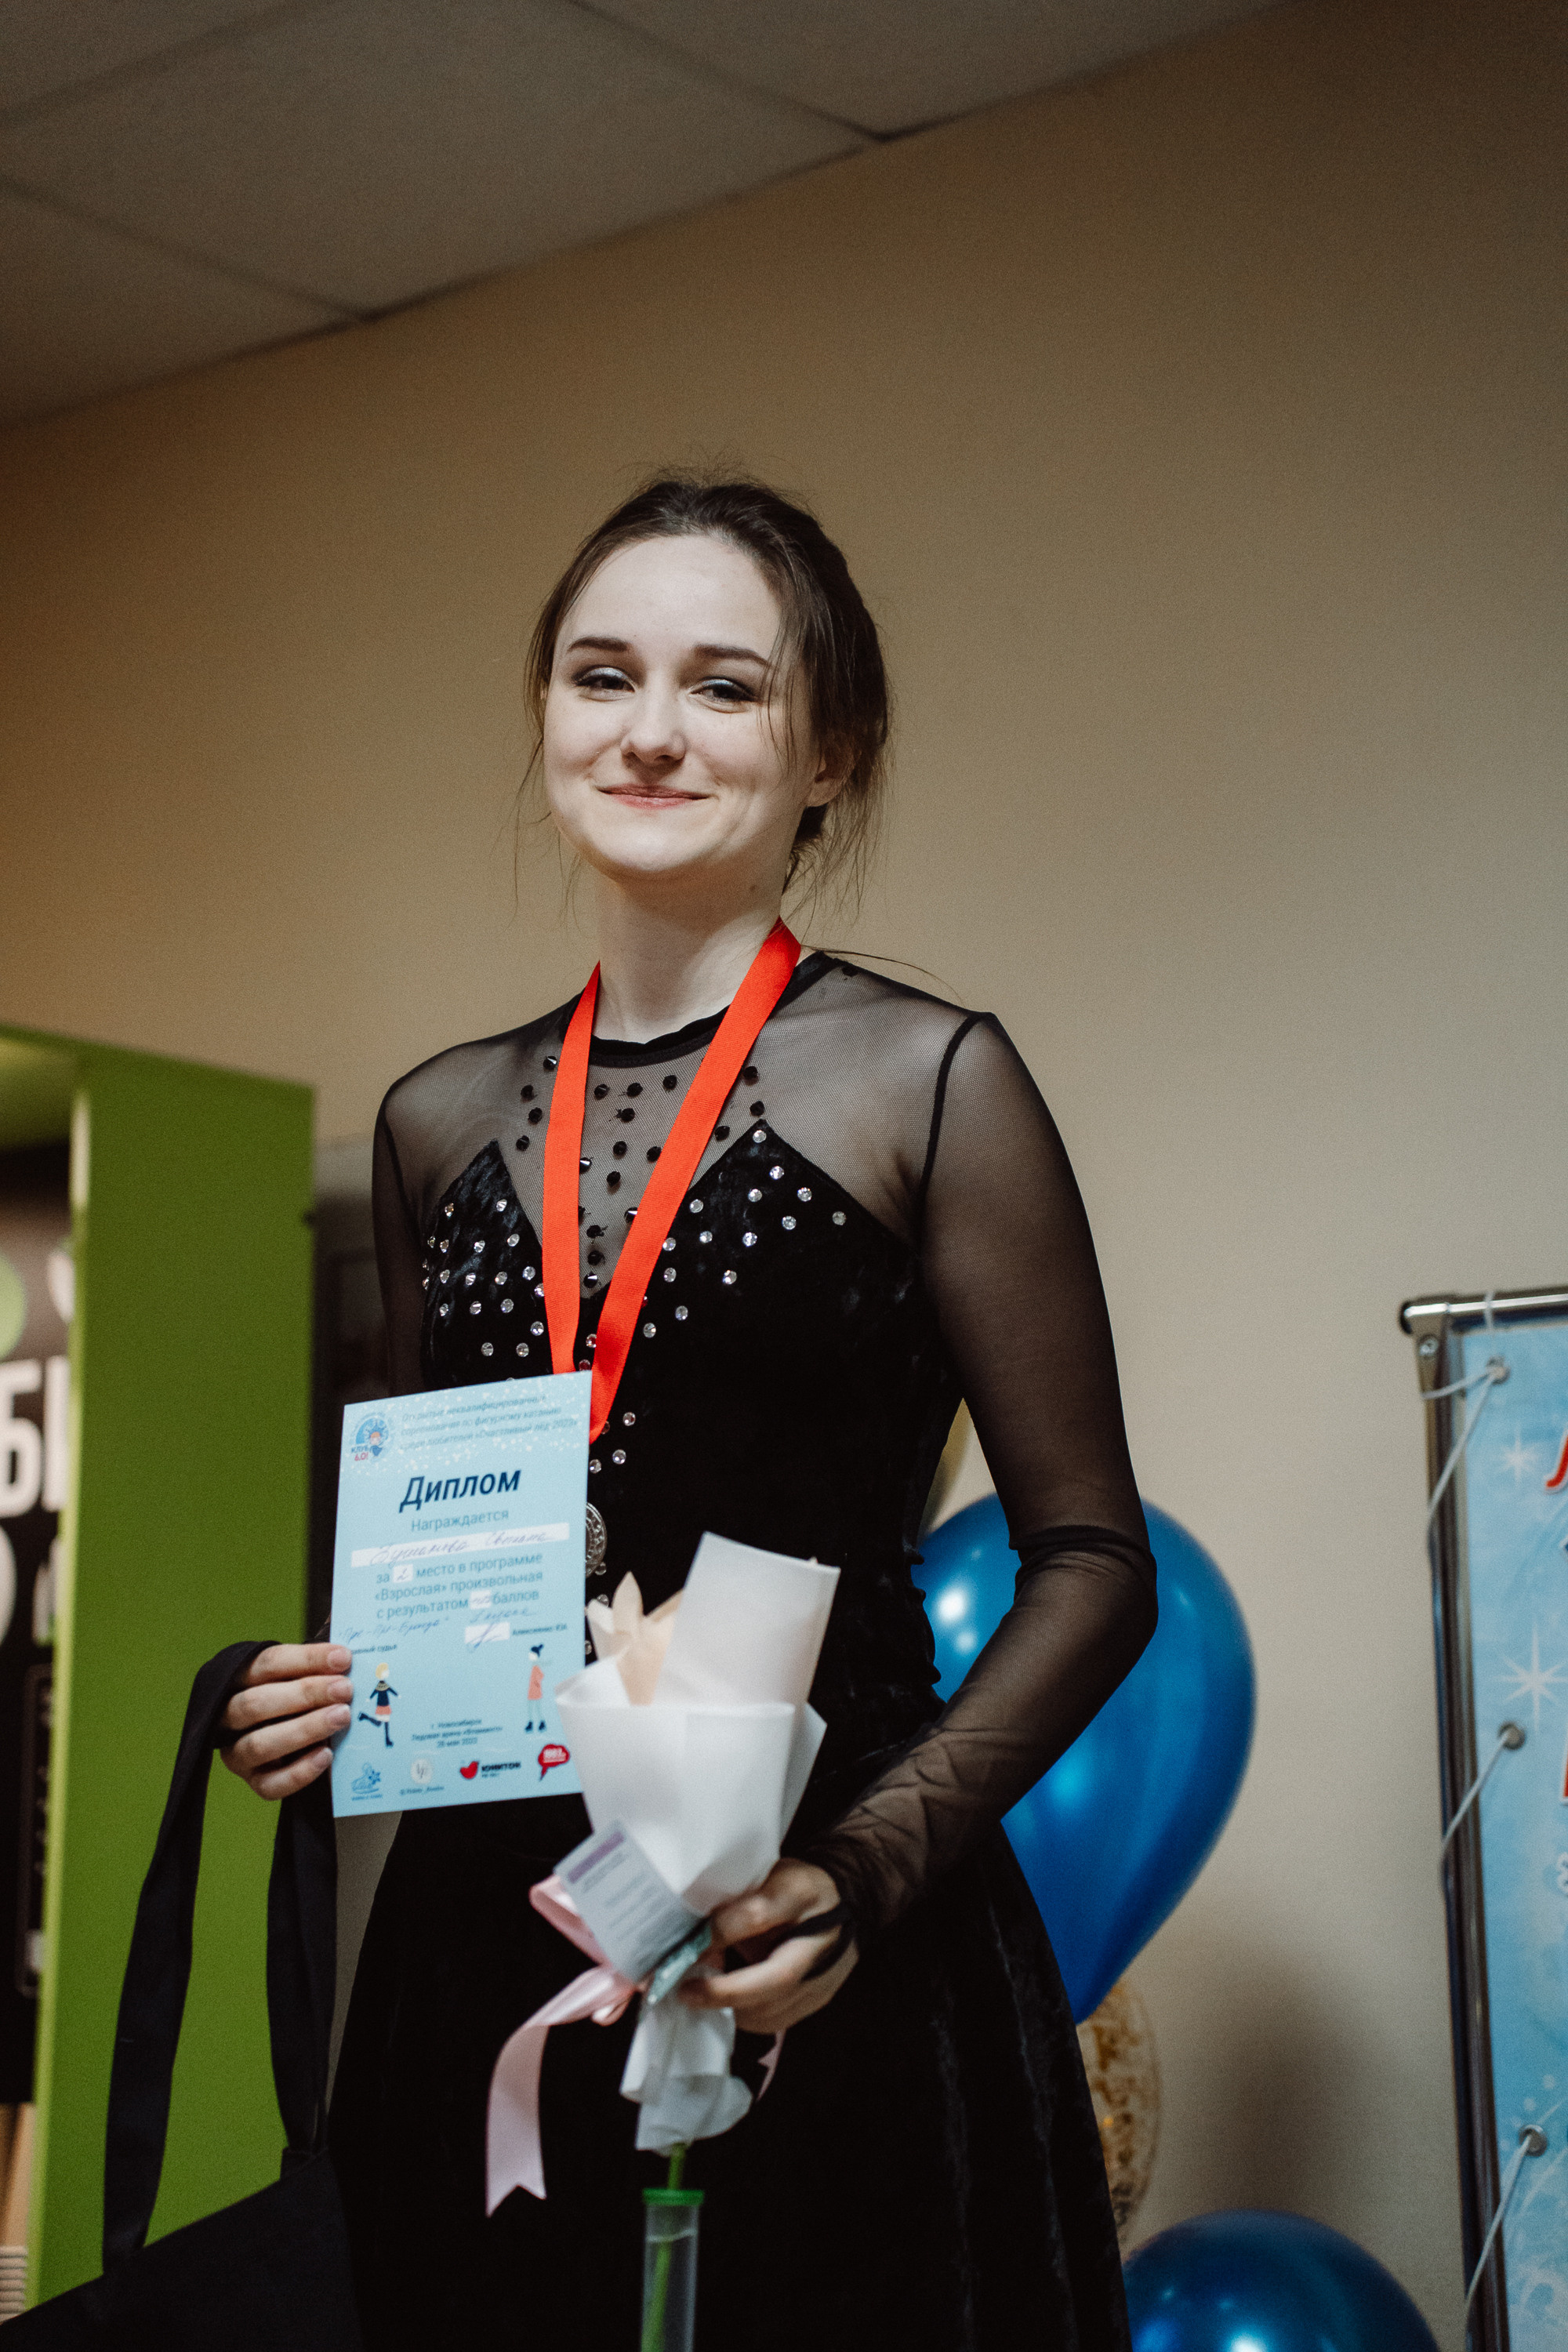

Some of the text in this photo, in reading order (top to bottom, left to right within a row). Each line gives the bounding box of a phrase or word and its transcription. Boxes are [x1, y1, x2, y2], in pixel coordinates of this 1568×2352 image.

[399, 1469, 521, 1513] Диплом
[412, 1510, 509, 1532] Награждается
[376, 1573, 390, 1584] за
[416, 1563, 456, 1578] место
[459, 1563, 466, 1573] в
[470, 1552, 543, 1572] программе
[375, 1572, 543, 1601] «Взрослая» произвольная
[376, 1609, 383, 1619] с
[387, 1599, 469, 1621] результатом
[492, 1590, 539, 1605] баллов
